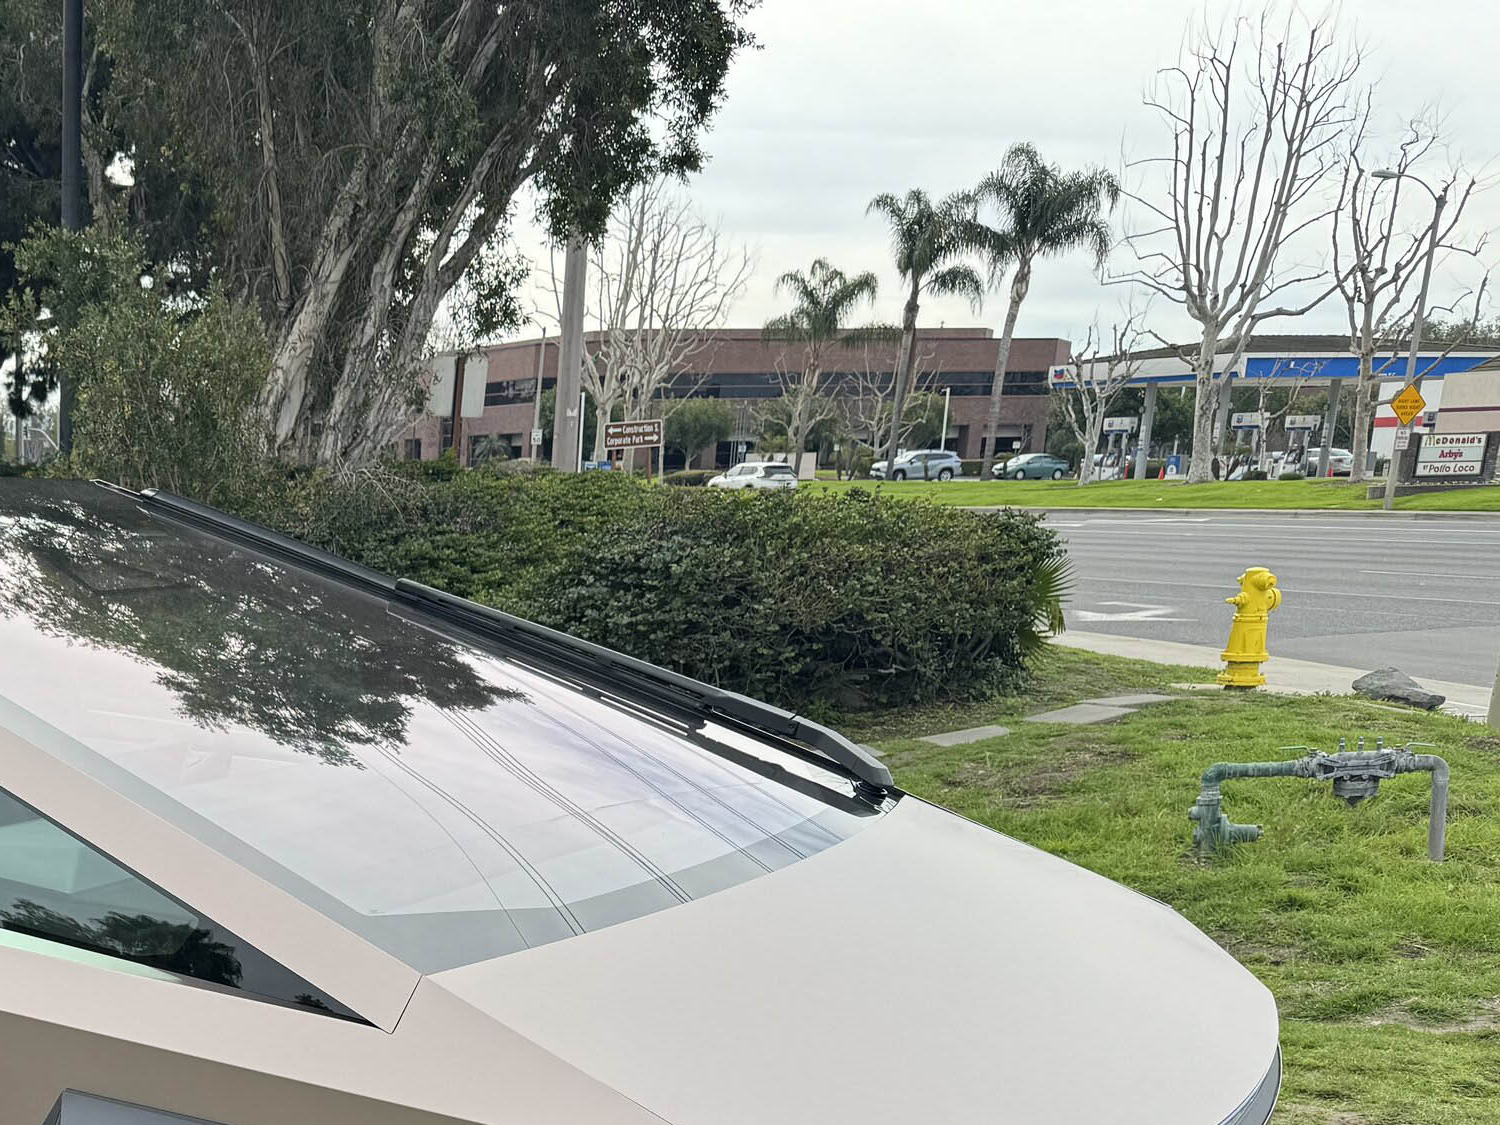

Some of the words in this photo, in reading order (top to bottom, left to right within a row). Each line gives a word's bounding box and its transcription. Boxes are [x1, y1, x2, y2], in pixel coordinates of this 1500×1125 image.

[622, 424, 653, 434] Construction
[606, 436, 631, 446] Corporate
[632, 435, 643, 443] Park
[1424, 435, 1482, 447] McDonald's
[1438, 449, 1464, 460] Arby's
[1428, 464, 1451, 473] Pollo
[1453, 464, 1475, 473] Loco
